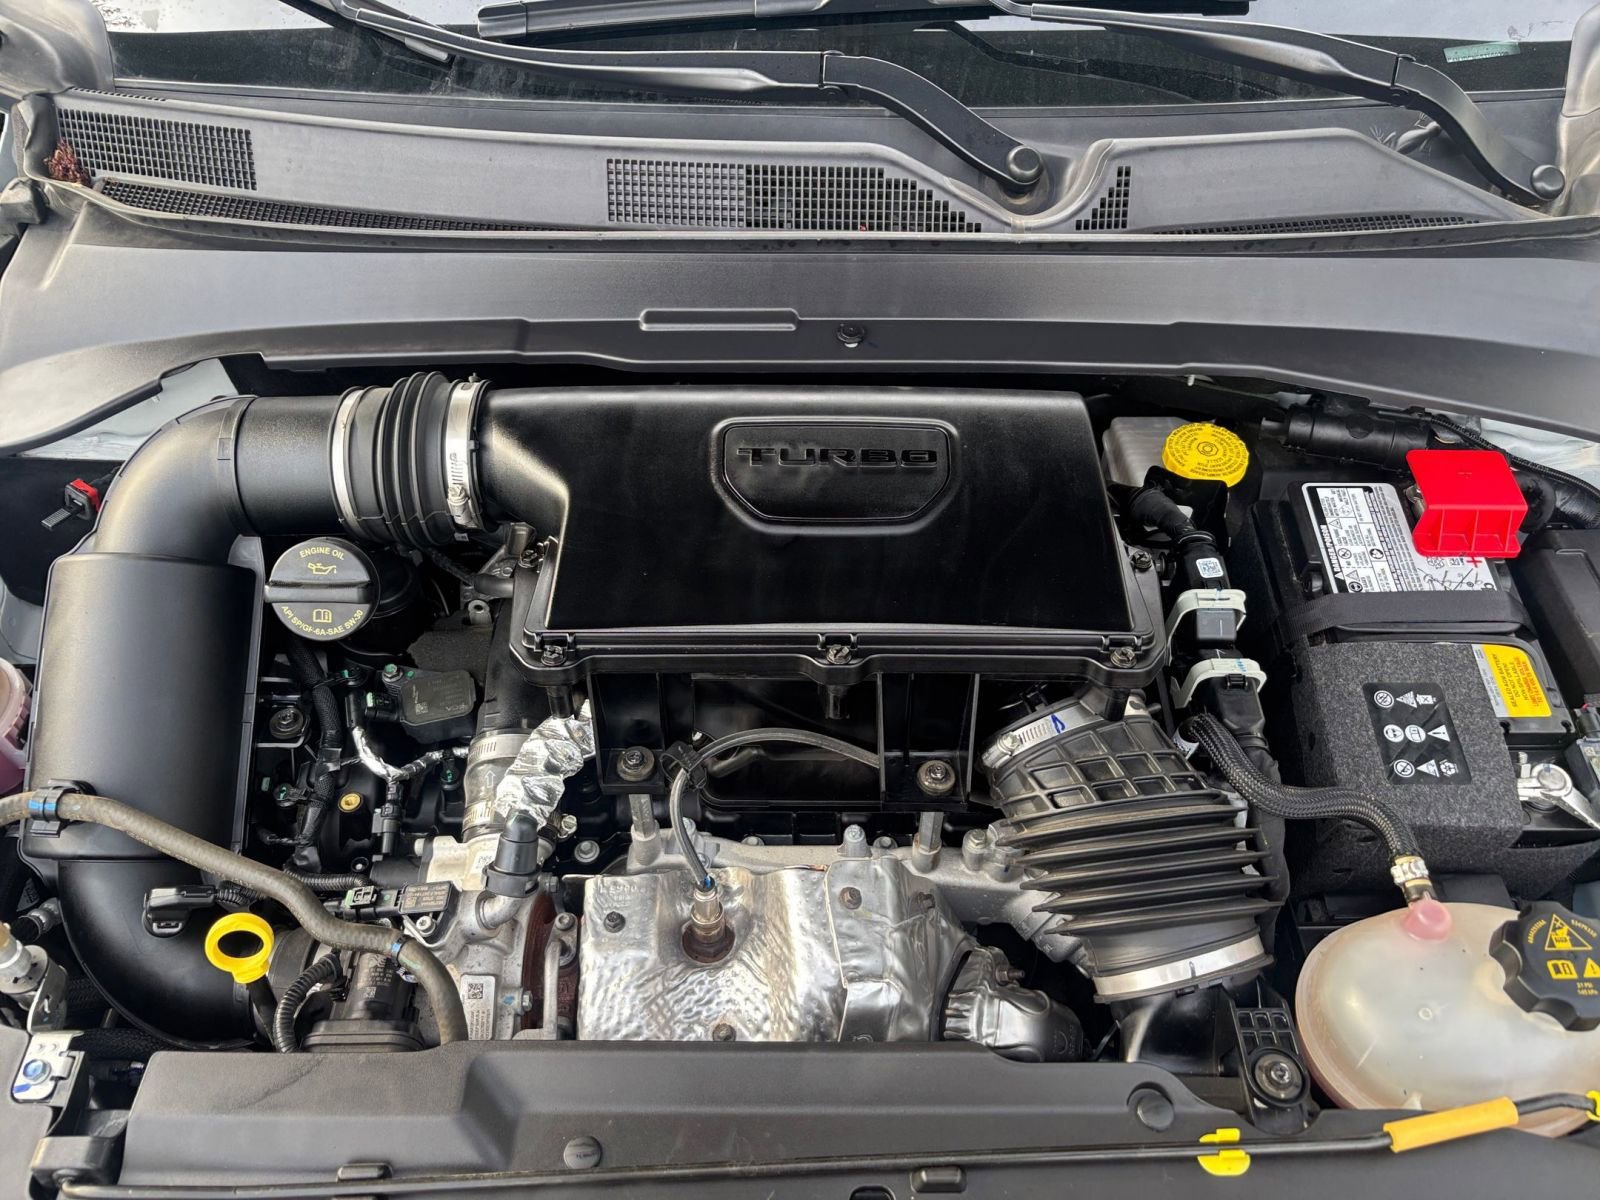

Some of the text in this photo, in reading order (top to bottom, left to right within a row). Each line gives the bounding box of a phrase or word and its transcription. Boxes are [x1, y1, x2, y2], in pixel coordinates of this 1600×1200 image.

[736, 447, 938, 468] TURBO
[299, 546, 345, 561] ENGINE OIL
[281, 606, 294, 619] API
